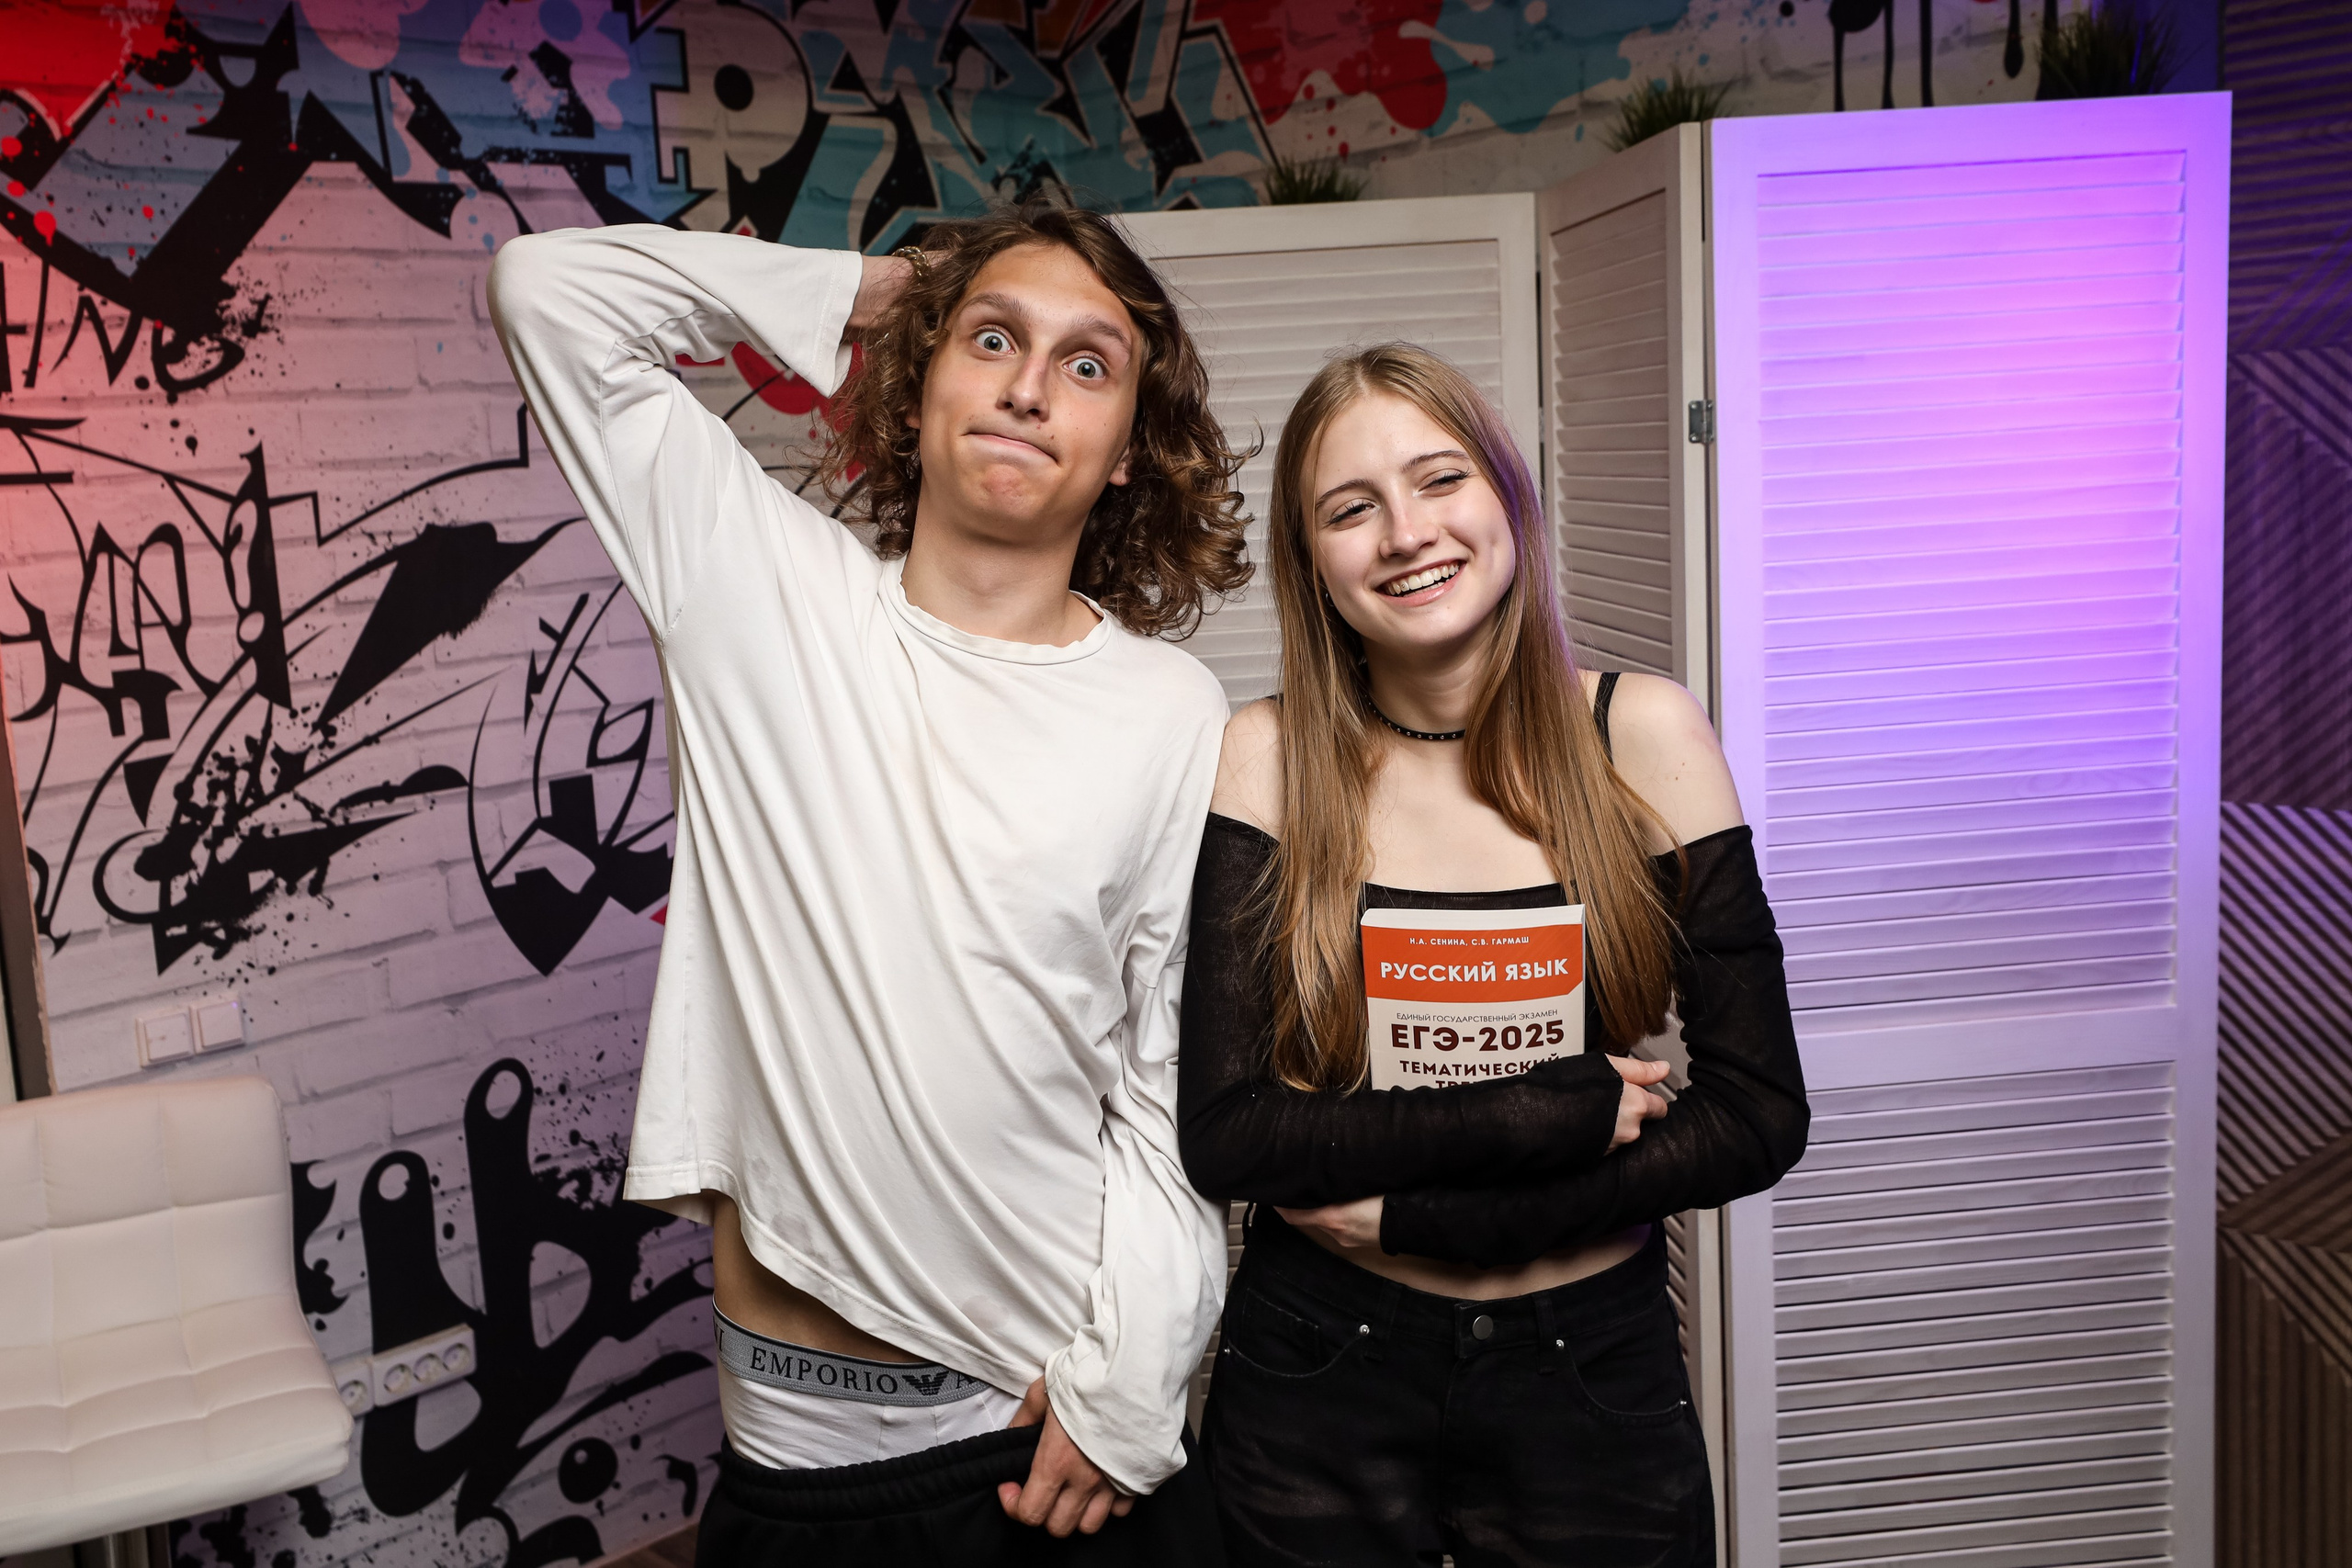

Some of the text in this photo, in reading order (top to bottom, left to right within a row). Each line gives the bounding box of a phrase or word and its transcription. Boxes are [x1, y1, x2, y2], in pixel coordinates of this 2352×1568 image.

[1430, 938, 1468, 946] СЕНИНА,
[1491, 936, 1530, 945] ГАРМАШ
[1380, 956, 1568, 982] РУССКИЙ ЯЗЫК
[1396, 1009, 1558, 1023] ЕДИНЫЙ ГОСУДАРСТВЕННЫЙ ЭКЗАМЕН
[1391, 1020, 1564, 1052] ЕГЭ-2025
[750, 1346, 898, 1394] EMPORIO
